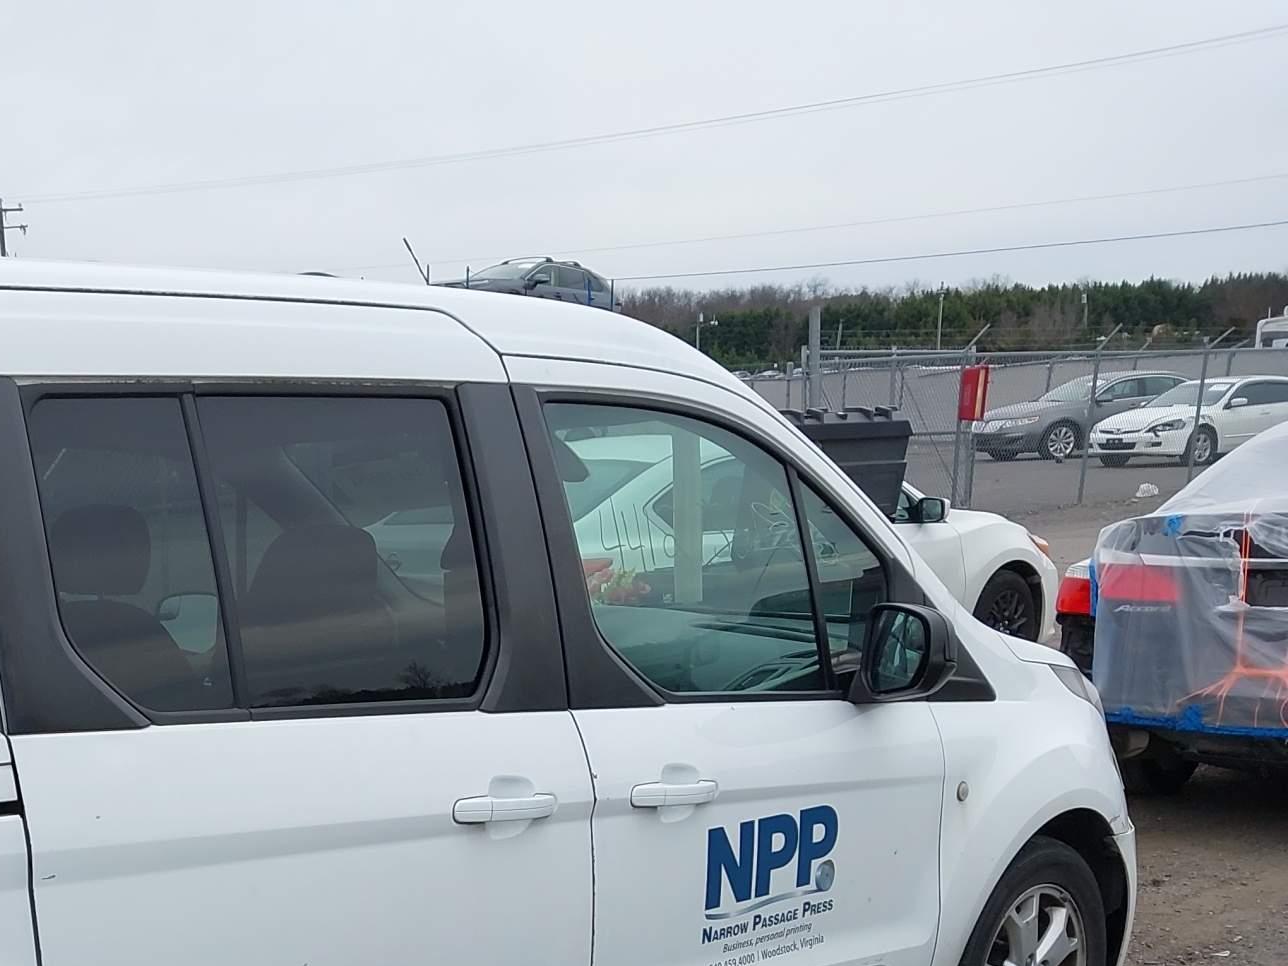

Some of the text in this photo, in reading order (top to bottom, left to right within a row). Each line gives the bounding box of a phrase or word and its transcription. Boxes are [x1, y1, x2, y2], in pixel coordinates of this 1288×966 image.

[704, 805, 839, 911] NPP
[755, 928, 786, 946] personal
[786, 922, 813, 939] printing
[761, 941, 800, 961] Woodstock,
[800, 933, 825, 951] Virginia
